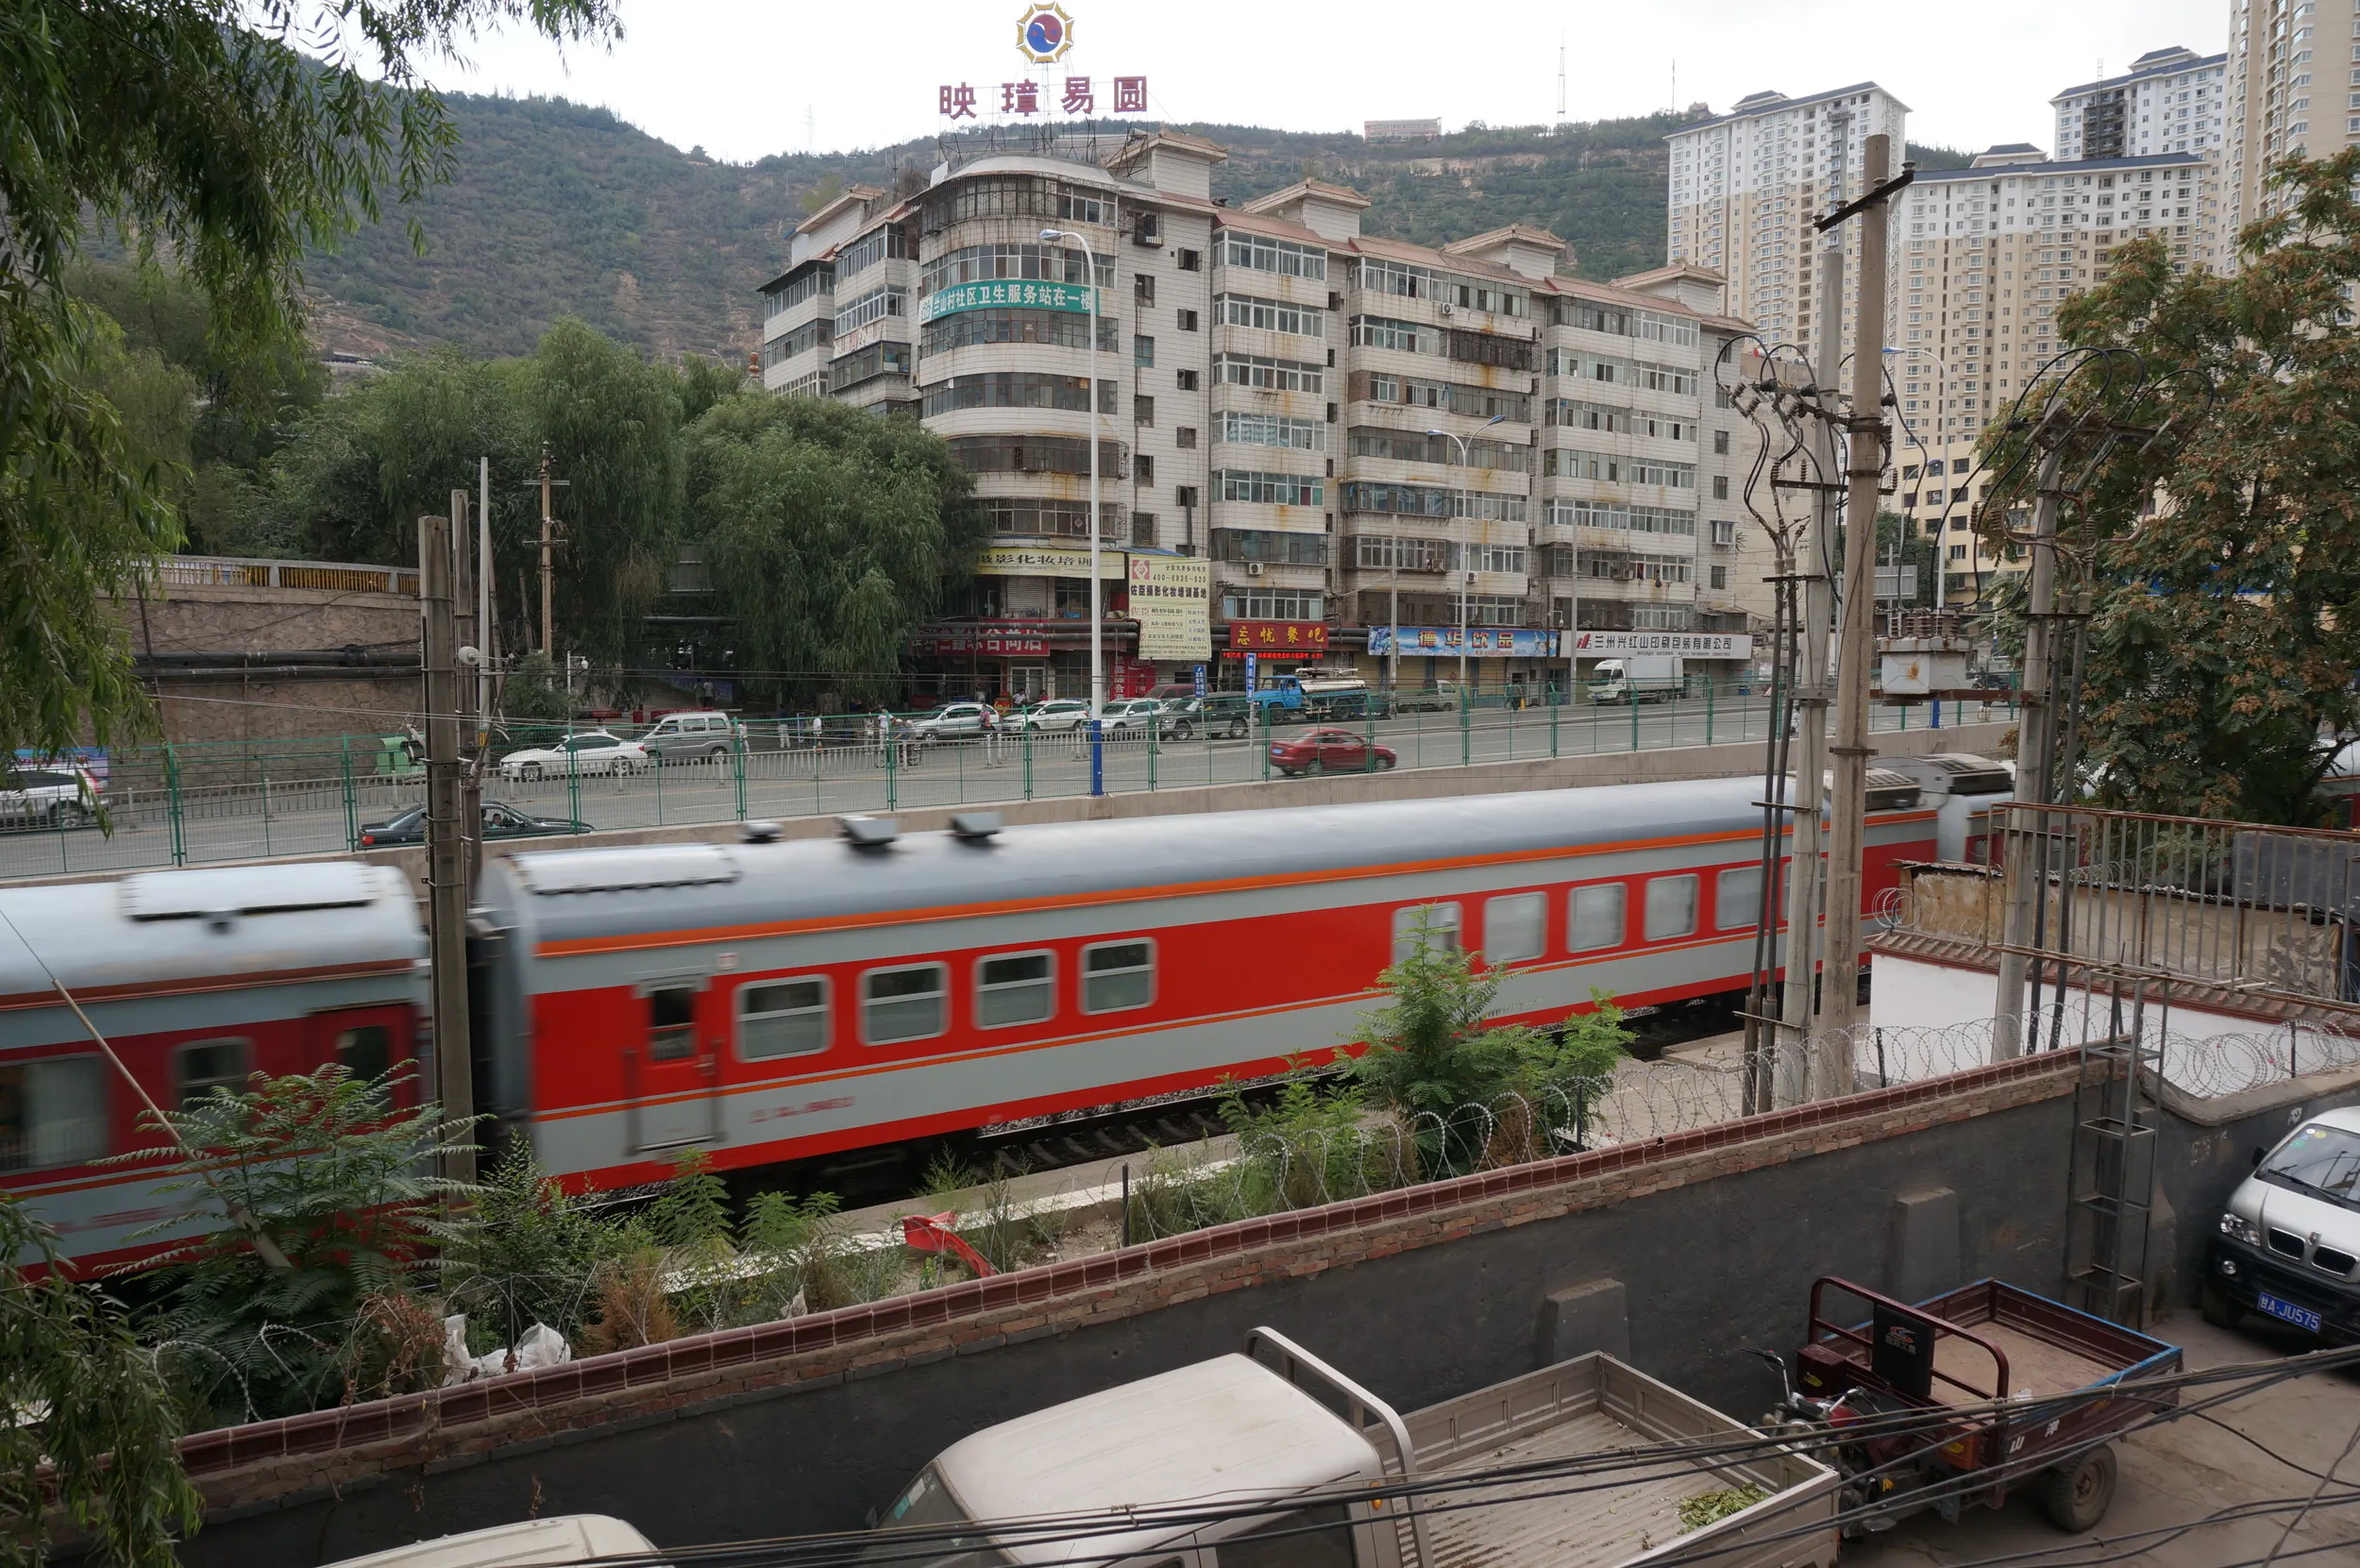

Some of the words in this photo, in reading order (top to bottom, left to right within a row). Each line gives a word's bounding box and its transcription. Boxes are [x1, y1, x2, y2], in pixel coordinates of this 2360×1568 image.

[938, 75, 1147, 121] 映璋易圆
[1153, 573, 1206, 583] 400-6935-520
[1418, 630, 1514, 649] 德华饮品
[1594, 634, 1732, 650] 兰州兴红山印刷包装有限公司
